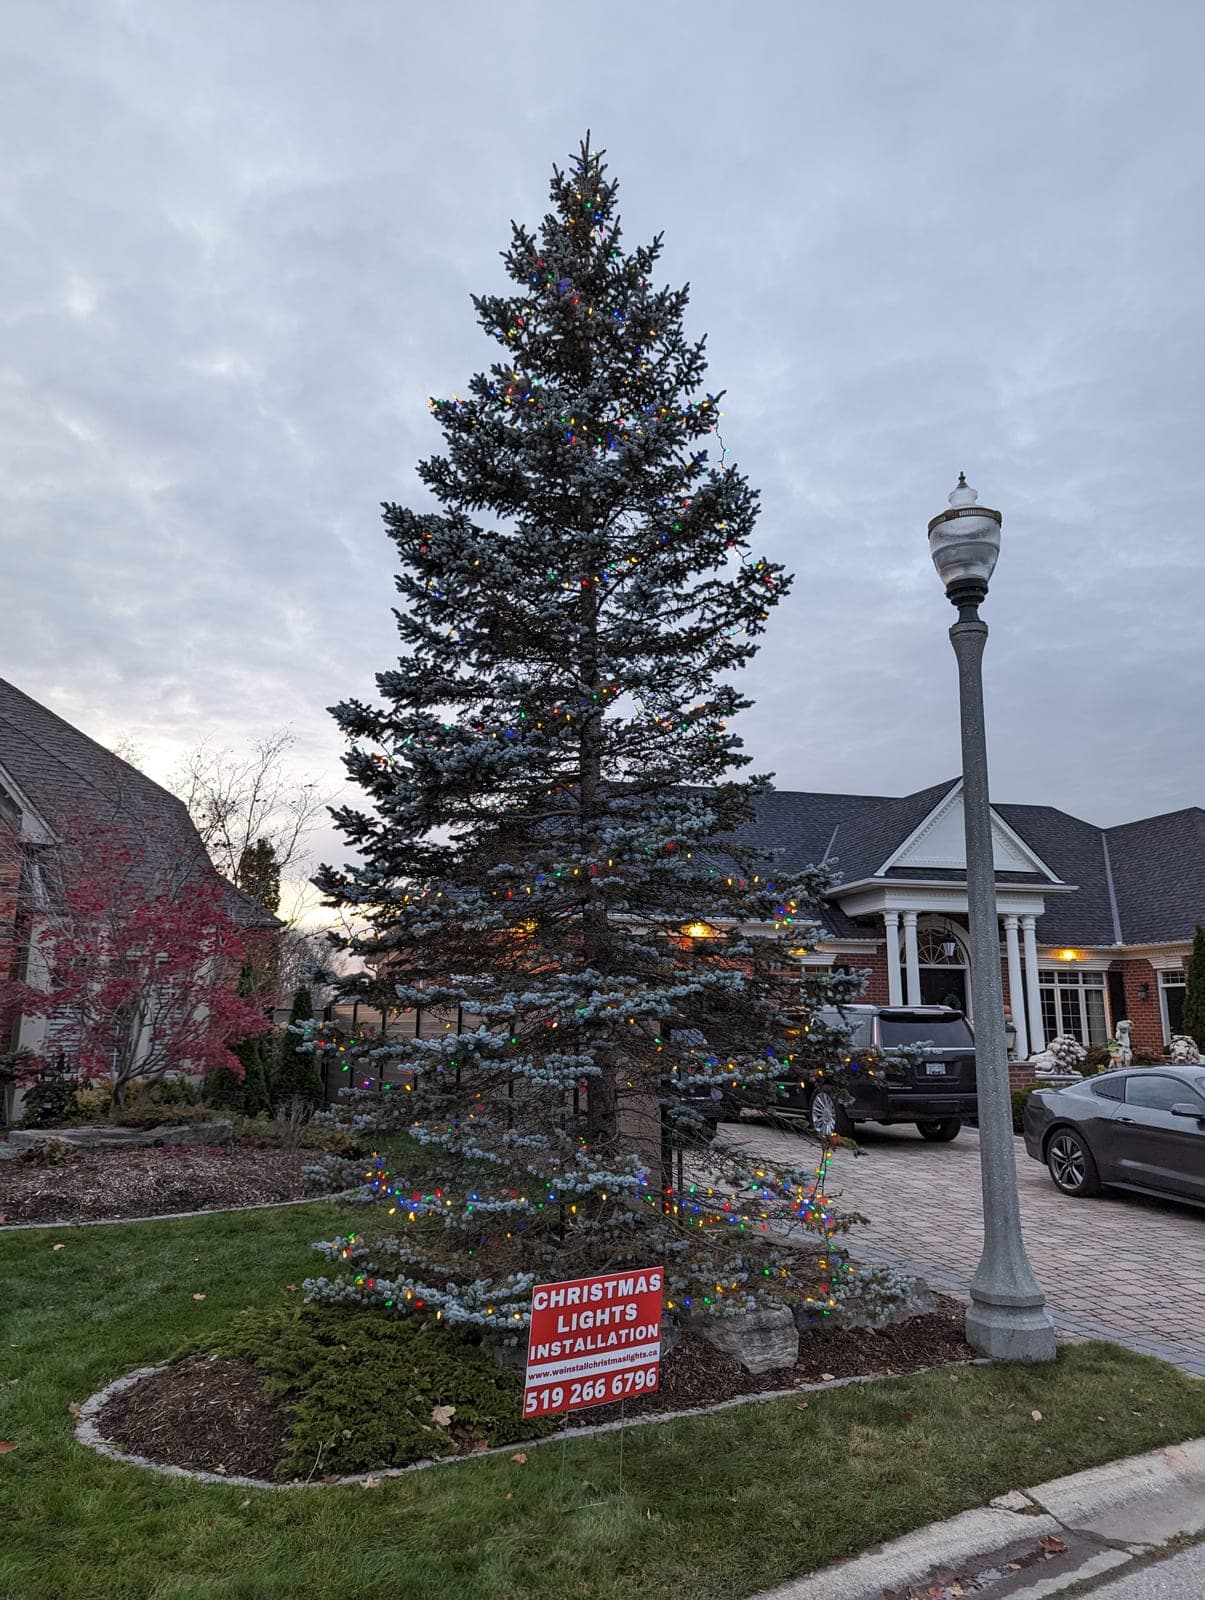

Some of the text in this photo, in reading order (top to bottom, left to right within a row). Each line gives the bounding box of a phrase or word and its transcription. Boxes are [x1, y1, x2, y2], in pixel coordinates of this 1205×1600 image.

[533, 1274, 661, 1311] CHRISTMAS
[557, 1303, 638, 1334] LIGHTS
[529, 1323, 659, 1361] INSTALLATION
[528, 1349, 658, 1381] www.weinstallchristmaslights.ca
[525, 1367, 657, 1413] 519 266 6796
